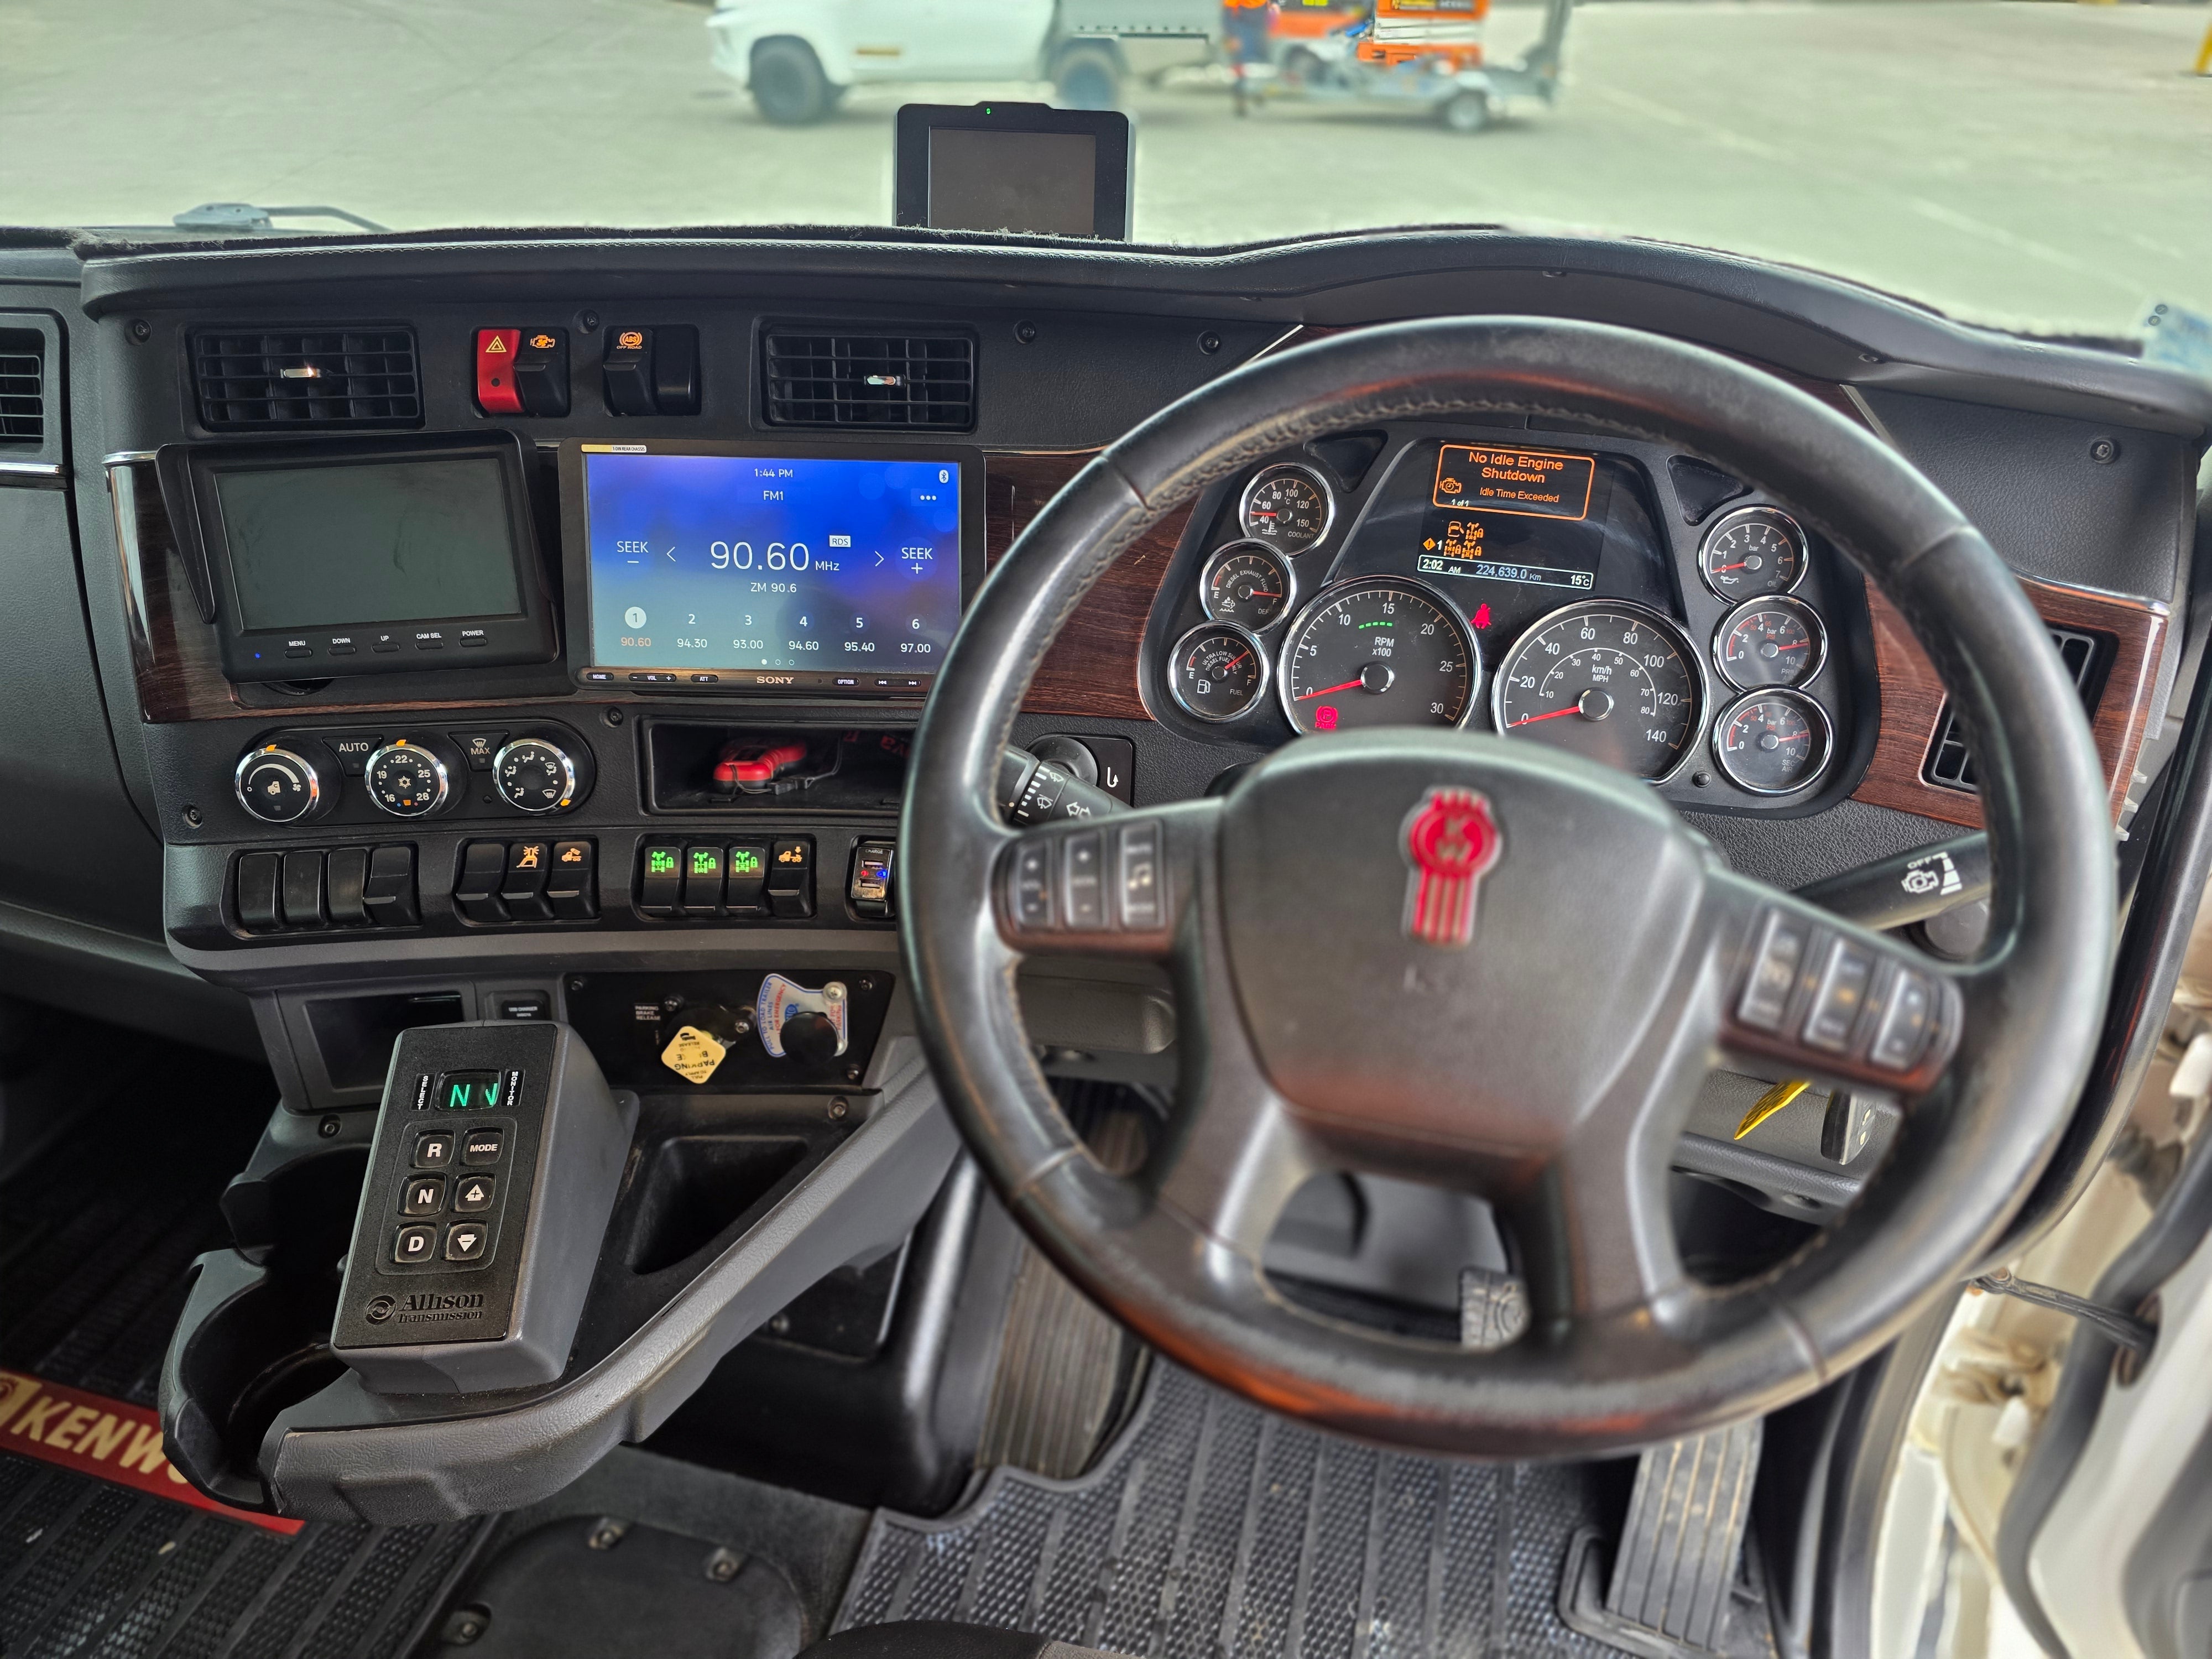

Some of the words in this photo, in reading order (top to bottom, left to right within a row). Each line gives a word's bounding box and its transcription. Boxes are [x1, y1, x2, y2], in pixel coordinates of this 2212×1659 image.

[1469, 452, 1487, 464] No
[1490, 454, 1515, 467] Idle
[1518, 456, 1563, 471] Engine
[754, 468, 775, 478] 1:44
[779, 468, 793, 478] PM
[1481, 467, 1546, 483] Shutdown
[763, 491, 784, 501] FM1
[1272, 491, 1281, 499] 80
[1286, 488, 1298, 497] 100
[1480, 487, 1494, 497] Idle
[1495, 489, 1516, 499] Time
[1518, 491, 1559, 503] Exceeded
[1262, 501, 1271, 509] 60
[1297, 500, 1309, 509] 120
[1297, 519, 1309, 528] 150
[832, 537, 848, 546] RDS
[1437, 540, 1442, 550] 1
[1730, 540, 1736, 549] 2
[617, 541, 649, 554] SEEK
[1771, 544, 1777, 552] 5
[710, 541, 810, 571] 90.60
[815, 561, 839, 572] MHz
[901, 547, 933, 560] SEEK
[1422, 559, 1443, 571] 2:02
[1476, 565, 1527, 579] 224,639.0
[1226, 573, 1239, 588] DIESEL
[1240, 570, 1261, 579] EXHAUST
[750, 582, 766, 593] ZM
[771, 583, 797, 593] 90.6
[1382, 603, 1395, 614] 15
[632, 612, 638, 623] 1
[688, 614, 696, 624] 2
[745, 615, 752, 626] 3
[800, 617, 808, 627] 4
[855, 618, 863, 628] 5
[1338, 614, 1351, 625] 10
[912, 619, 920, 629] 6
[1421, 624, 1434, 635] 20
[1758, 623, 1764, 632] 4
[1580, 628, 1595, 640] 60
[1780, 626, 1785, 634] 6
[620, 637, 651, 647] 90.60
[677, 638, 708, 649] 94.30
[1374, 637, 1394, 647] RPM
[1623, 632, 1638, 644] 80
[1743, 634, 1748, 643] 2
[733, 639, 764, 649] 93.00
[789, 640, 819, 651] 94.60
[844, 641, 875, 652] 95.40
[900, 643, 931, 653] 97.00
[1545, 643, 1560, 655] 40
[1310, 645, 1317, 656] 5
[1372, 648, 1391, 656] x100
[1739, 651, 1744, 659] 0
[1202, 653, 1215, 665] ULTRA
[1644, 655, 1665, 667] 100
[1786, 656, 1795, 664] 10
[1206, 659, 1218, 671] DIESEL
[1439, 661, 1453, 672] 25
[1592, 665, 1612, 675] km/h
[1520, 676, 1535, 688] 20
[1658, 692, 1678, 705] 120
[1430, 702, 1444, 713] 30
[1743, 725, 1749, 733] 2
[1646, 729, 1667, 742] 140
[339, 742, 369, 752] AUTO
[1739, 741, 1744, 749] 0
[1786, 747, 1796, 755] 10
[377, 771, 387, 779] 19
[418, 770, 431, 778] 25
[416, 792, 429, 801] 28
[1907, 856, 1932, 869] OFF
[761, 982, 772, 1004] TRAILER
[775, 983, 786, 1019] EMERGENCY
[418, 1075, 429, 1110] SELECT
[507, 1071, 518, 1105] MONITOR
[450, 1084, 470, 1107] N
[427, 1143, 442, 1157] R
[469, 1144, 498, 1152] MODE
[418, 1189, 434, 1204] N
[408, 1236, 424, 1252] D
[399, 1294, 484, 1311] Allison
[398, 1311, 482, 1323] Transmission
